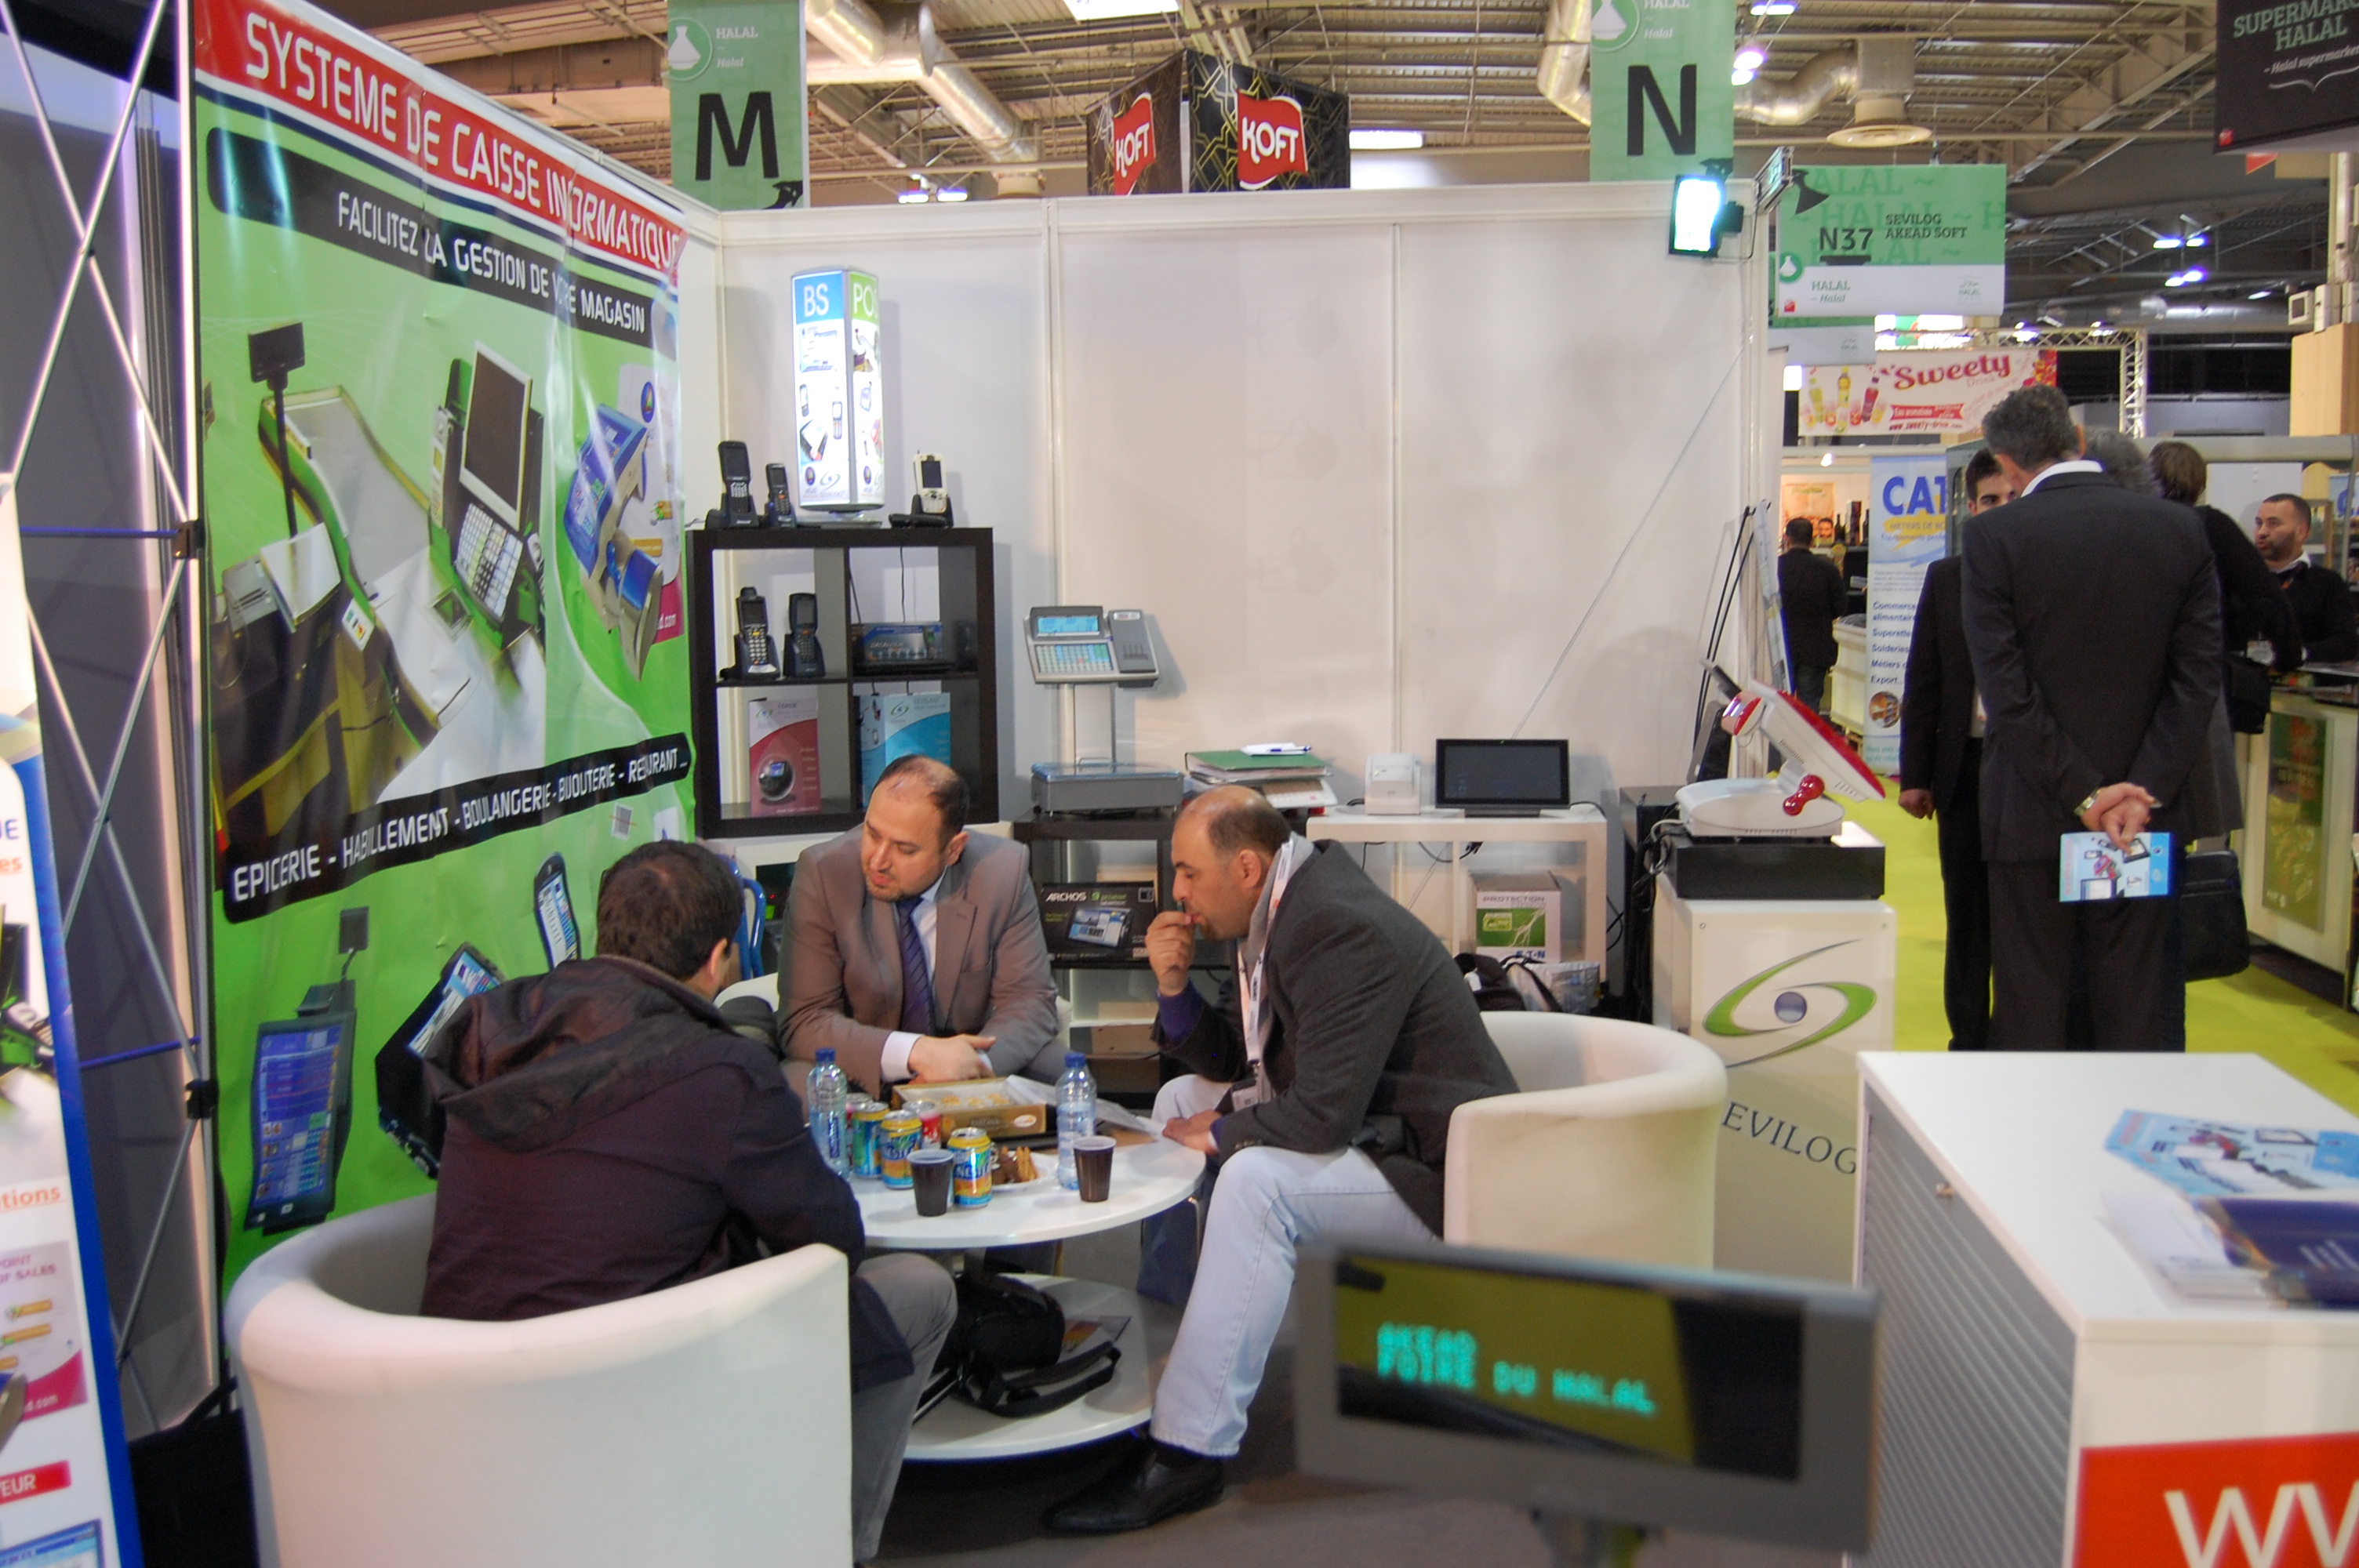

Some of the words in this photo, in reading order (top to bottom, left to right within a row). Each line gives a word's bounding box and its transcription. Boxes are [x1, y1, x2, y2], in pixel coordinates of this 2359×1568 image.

[716, 27, 758, 38] HALAL
[1644, 27, 1674, 38] Halal
[2234, 0, 2359, 38] SUPERMAR
[2274, 15, 2348, 52] HALAL
[717, 57, 744, 67] Halal
[2271, 57, 2298, 74] Halal
[245, 13, 398, 143] SYSTEME
[407, 96, 442, 165] DE
[452, 123, 541, 209] CAISSE
[1627, 64, 1697, 156] N
[696, 91, 780, 181] M
[1116, 122, 1150, 177] KOFT
[1241, 116, 1299, 164] KOFT
[1885, 212, 1942, 226] SEVILOG
[1885, 227, 1931, 239] AKEAD
[1934, 227, 1968, 239] SOFT
[1819, 227, 1874, 251] N37
[338, 191, 420, 256] FACILITEZ
[454, 238, 526, 291] GESTION
[530, 262, 549, 298] DE
[581, 289, 645, 333] MAGASIN
[803, 283, 829, 318] BS
[1812, 281, 1851, 292] HALAL
[1819, 293, 1846, 303] Halal
[234, 844, 321, 902] EPICERIE
[343, 808, 449, 869] HABILLEMENT
[462, 782, 551, 830] BOULANGERIE
[558, 764, 615, 803] BIJOUTERIE
[1045, 891, 1088, 902] ARCHOS
[1721, 1102, 1857, 1174] EVILOG
